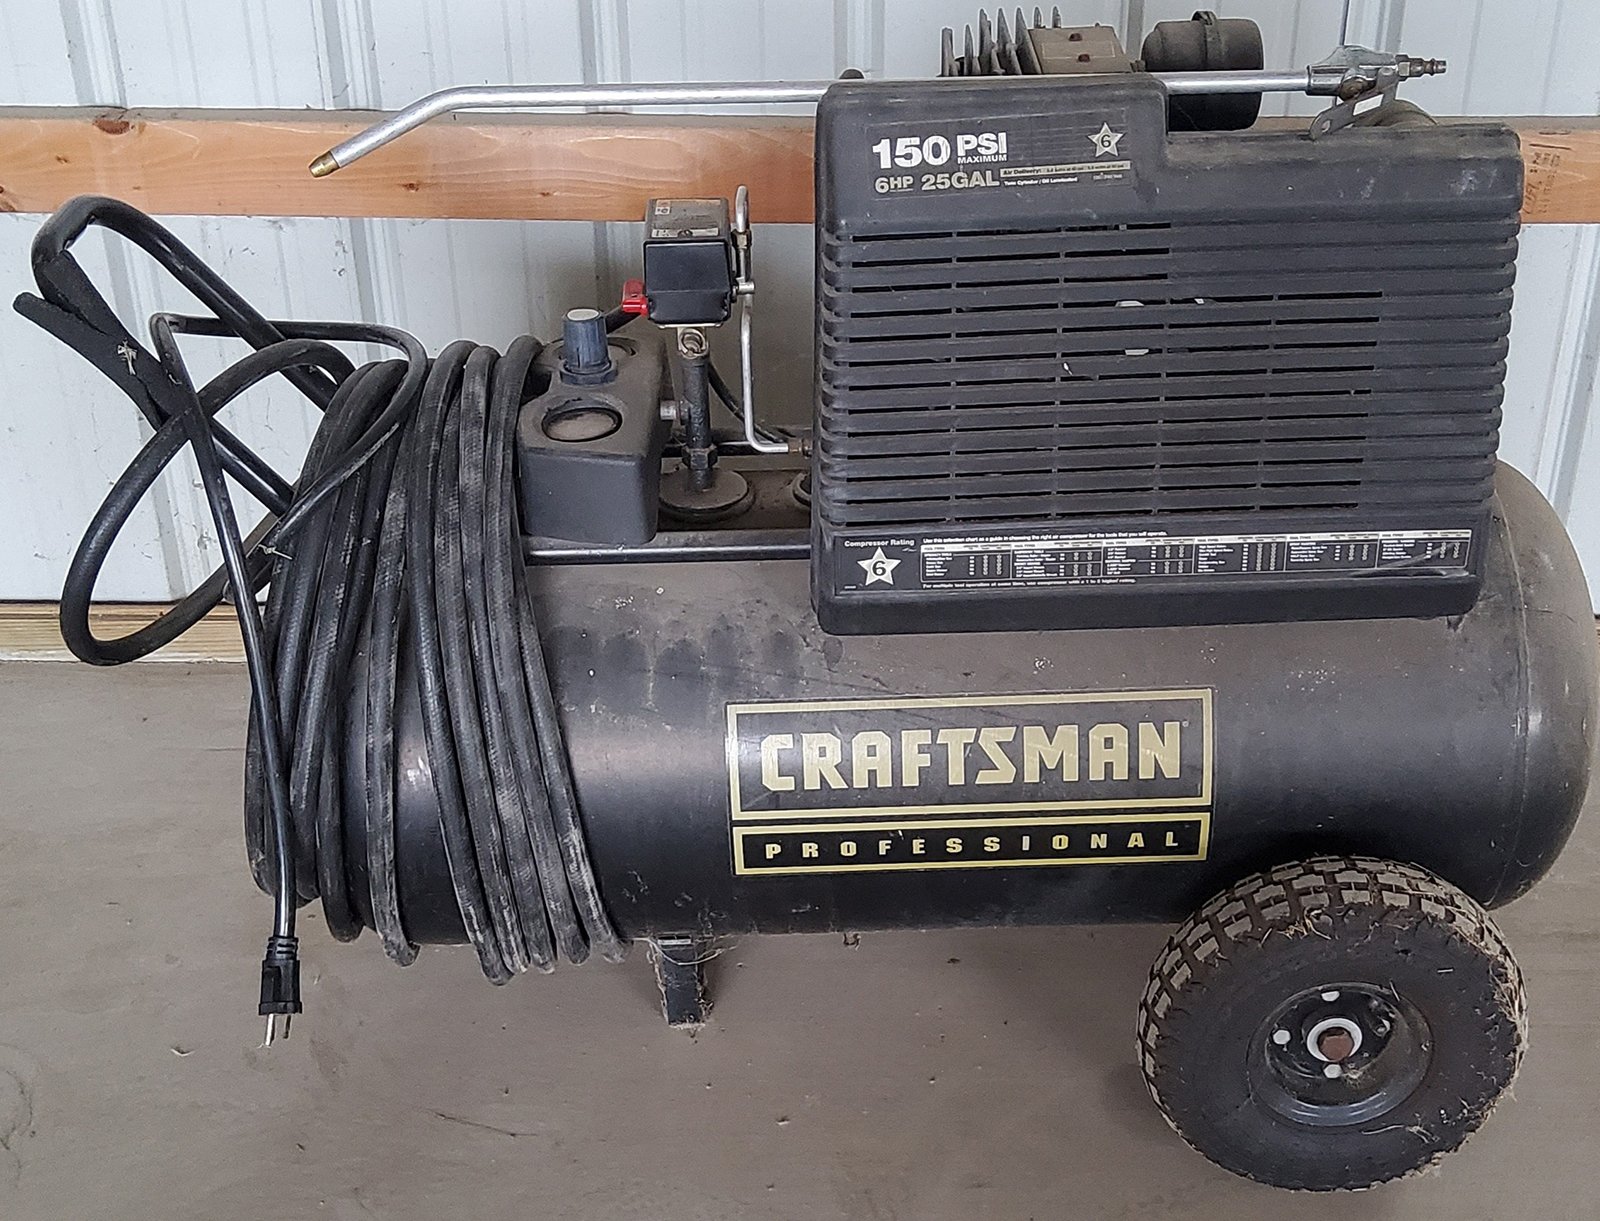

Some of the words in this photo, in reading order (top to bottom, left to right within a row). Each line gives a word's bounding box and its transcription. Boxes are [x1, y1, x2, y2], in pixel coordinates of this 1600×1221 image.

[872, 135, 951, 169] 150
[956, 132, 1008, 156] PSI
[1101, 134, 1111, 148] 6
[957, 154, 1007, 164] MAXIMUM
[875, 176, 914, 193] 6HP
[921, 170, 1000, 191] 25GAL
[872, 560, 886, 576] 6
[760, 721, 1181, 792] CRAFTSMAN
[765, 831, 1179, 860] PROFESSIONAL
